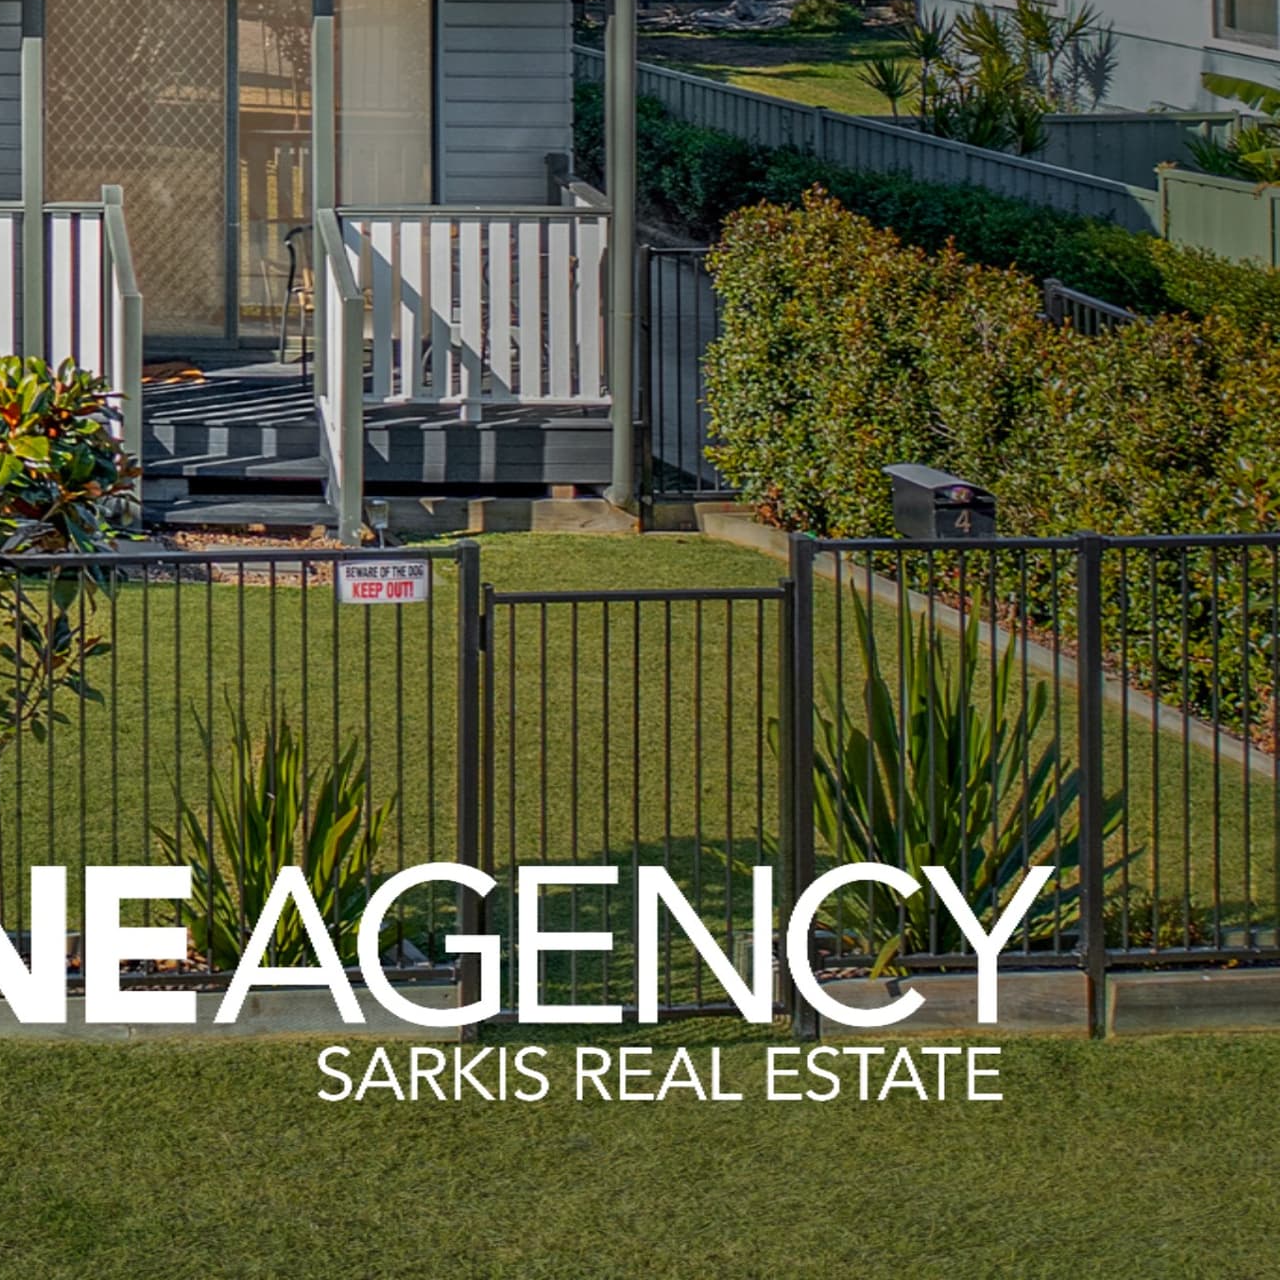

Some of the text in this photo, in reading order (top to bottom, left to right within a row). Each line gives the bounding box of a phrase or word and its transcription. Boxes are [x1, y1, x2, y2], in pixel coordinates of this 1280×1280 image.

[954, 509, 971, 533] 4
[345, 565, 424, 578] BEWARE OF THE DOG
[352, 580, 414, 598] KEEP OUT!
